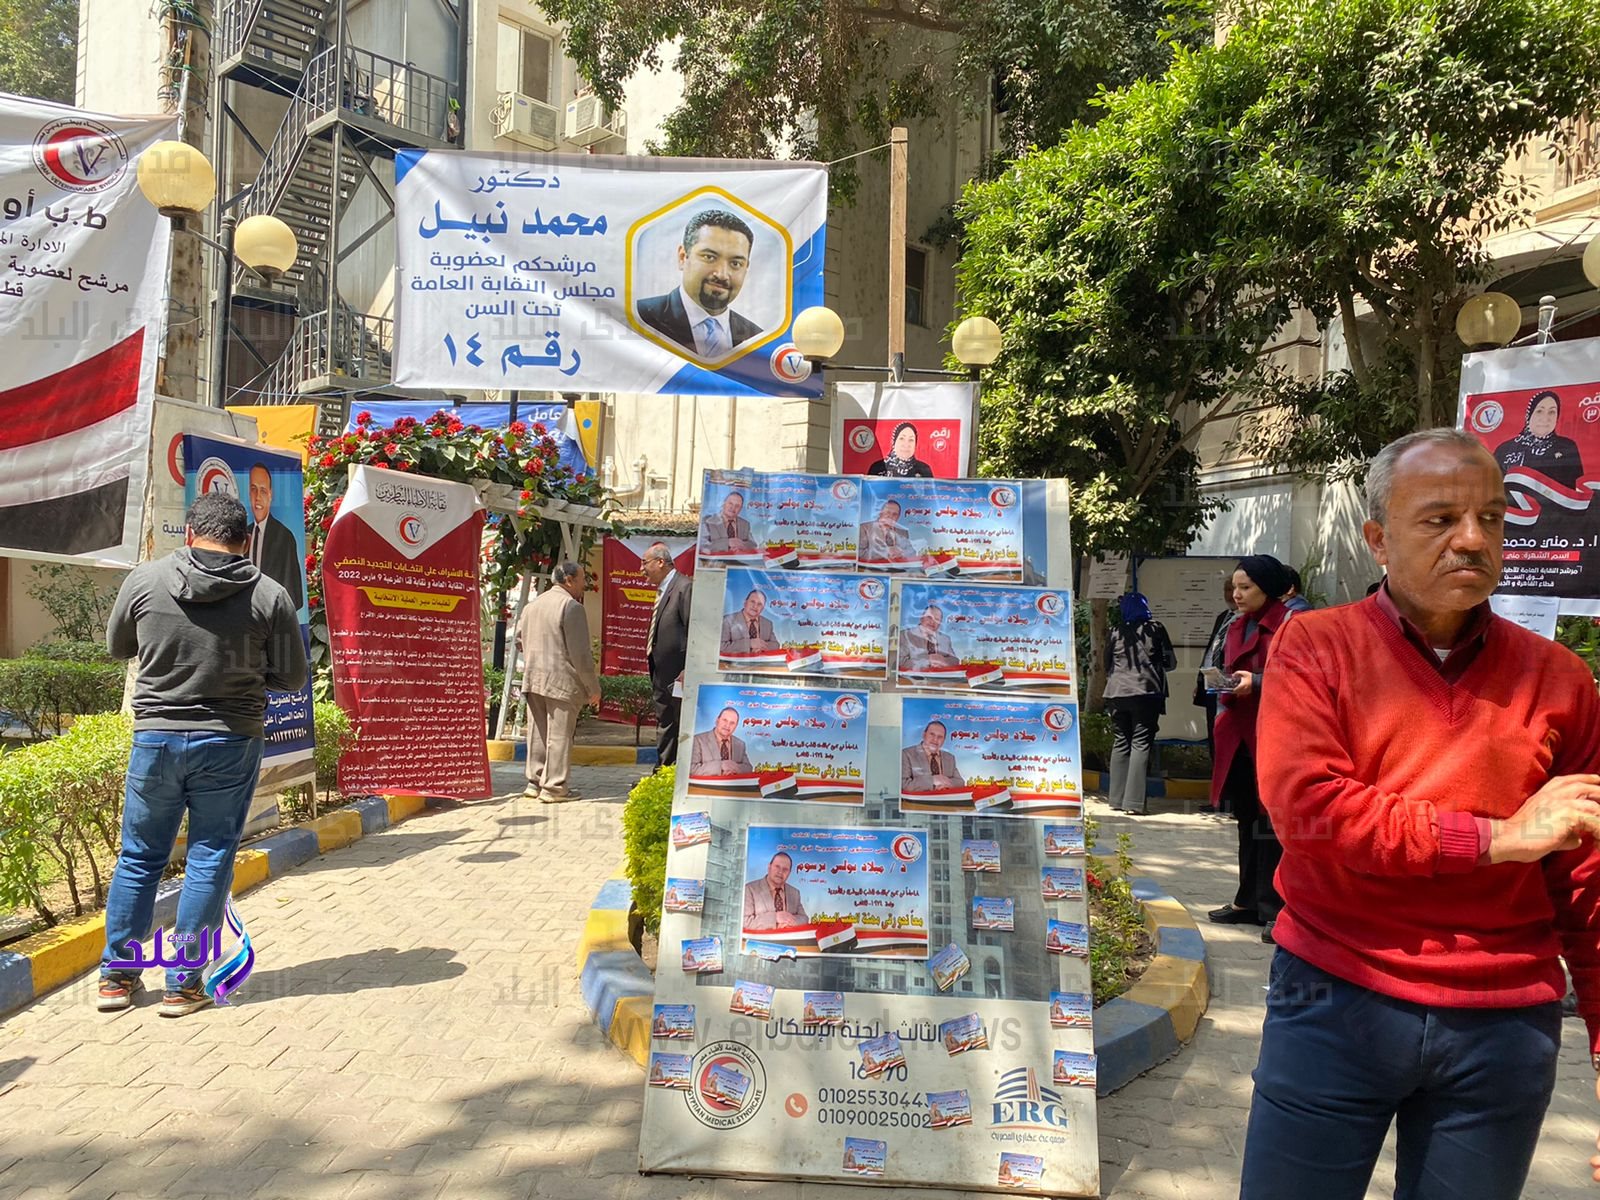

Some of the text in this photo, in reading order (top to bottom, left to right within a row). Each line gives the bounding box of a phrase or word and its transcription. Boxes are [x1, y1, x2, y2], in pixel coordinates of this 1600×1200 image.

[469, 170, 560, 192] دكتور
[418, 199, 608, 243] محمد نبيل
[8, 255, 129, 293] مرشح لعضوية
[429, 251, 596, 276] مرشحكم لعضوية
[411, 273, 615, 302] مجلس النقابة العامة
[465, 300, 561, 319] تحت السن
[443, 328, 581, 376] رقم ١٤
[930, 427, 950, 439] رقم
[1502, 538, 1537, 548] محمد
[1550, 552, 1570, 560] اسم
[334, 557, 463, 579] الاشراف على انتخابات التجديد النصفي
[338, 570, 360, 579] 2022
[1559, 567, 1578, 575] مرشح
[743, 715, 771, 727] برسوم
[775, 716, 800, 728] بولس
[950, 729, 979, 740] برسوم
[984, 729, 1009, 741] بولس
[796, 861, 826, 873] برسوم
[831, 860, 856, 874] بولس
[765, 1017, 834, 1042] الإسكان
[897, 1021, 942, 1042] الثالث
[849, 1061, 909, 1082] 1670
[705, 1113, 736, 1127] MEDICAL
[736, 1088, 763, 1122] SYNDICATE
[818, 1087, 928, 1108] 0102553044
[818, 1108, 932, 1129] 01090025002
[990, 1101, 1069, 1129] ERG
